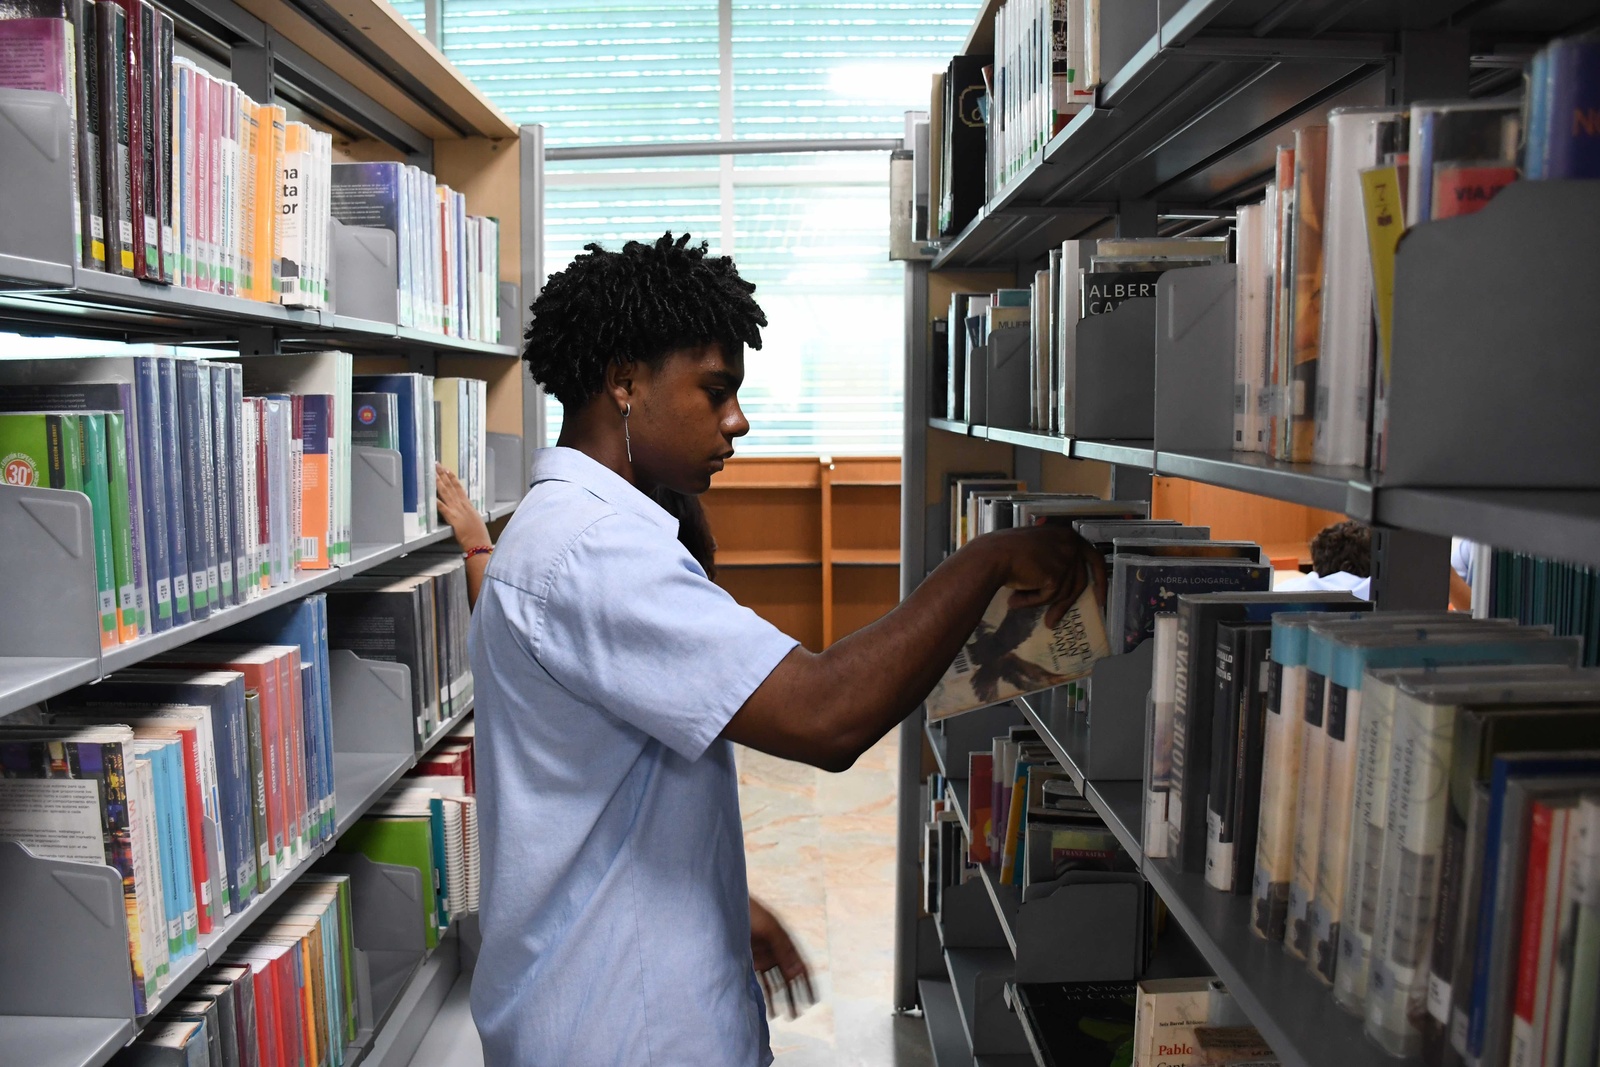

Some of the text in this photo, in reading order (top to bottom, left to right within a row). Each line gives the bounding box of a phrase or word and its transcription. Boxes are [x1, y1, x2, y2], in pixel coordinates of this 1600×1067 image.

[1089, 283, 1158, 298] ALBERT
[1089, 301, 1122, 315] CA
[1154, 576, 1240, 585] ANDREA LONGARELA
[1176, 627, 1189, 646] 8
[1079, 642, 1092, 664] DEL
[1172, 646, 1190, 713] TROYA
[1172, 719, 1187, 749] DE
[1363, 719, 1379, 797] ENFERMERA
[256, 770, 265, 816] CAÓTICA
[1397, 738, 1415, 820] ENFERMERA
[1387, 767, 1401, 832] HISTORIA
